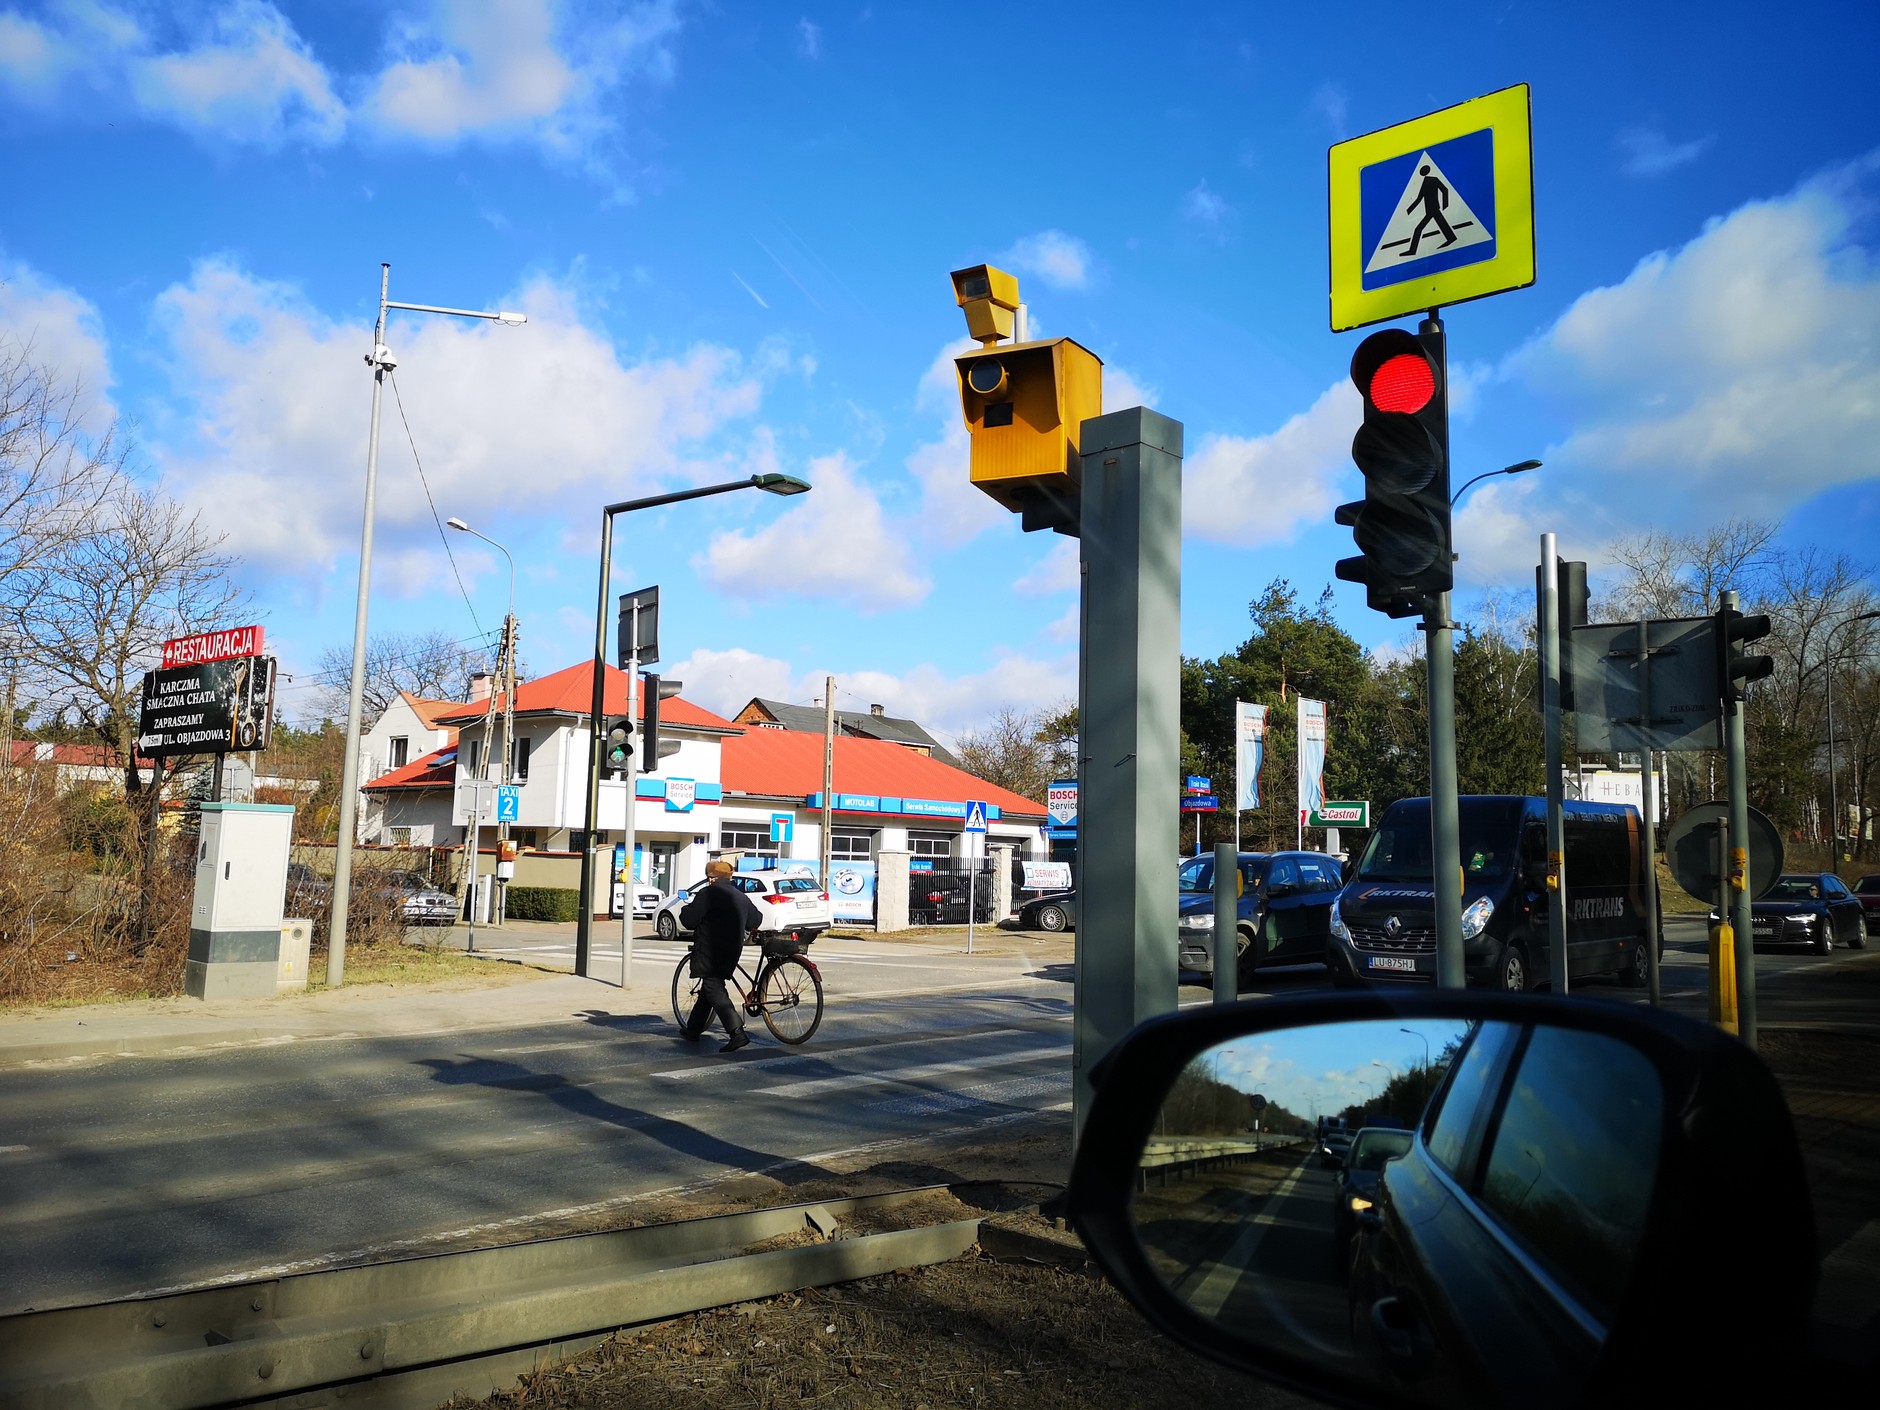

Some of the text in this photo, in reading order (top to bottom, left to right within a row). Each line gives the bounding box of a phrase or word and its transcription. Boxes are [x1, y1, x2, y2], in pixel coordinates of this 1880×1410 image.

[173, 629, 253, 664] RESTAURACJA
[160, 678, 201, 694] KARCZMA
[146, 690, 216, 711] SMACZNA CHATA
[153, 713, 205, 729] ZAPRASZAMY
[147, 736, 159, 746] 75m
[164, 729, 231, 745] UL. OBJAZDOWA 3
[500, 787, 518, 797] TAXI
[670, 783, 693, 791] BOSCH
[1600, 782, 1641, 796] HEBA
[670, 791, 693, 799] Service
[1050, 791, 1078, 800] BOSCH
[503, 797, 514, 815] 2
[845, 797, 875, 807] MOTOLAB
[1184, 799, 1211, 808] Objazdowa
[905, 802, 924, 811] Serwis
[924, 803, 961, 814] Samochodowy
[1328, 809, 1359, 819] Castrol
[1035, 869, 1060, 878] SERWIS
[1574, 896, 1624, 920] RKTRANS
[1374, 958, 1414, 969] LU 875HJ
